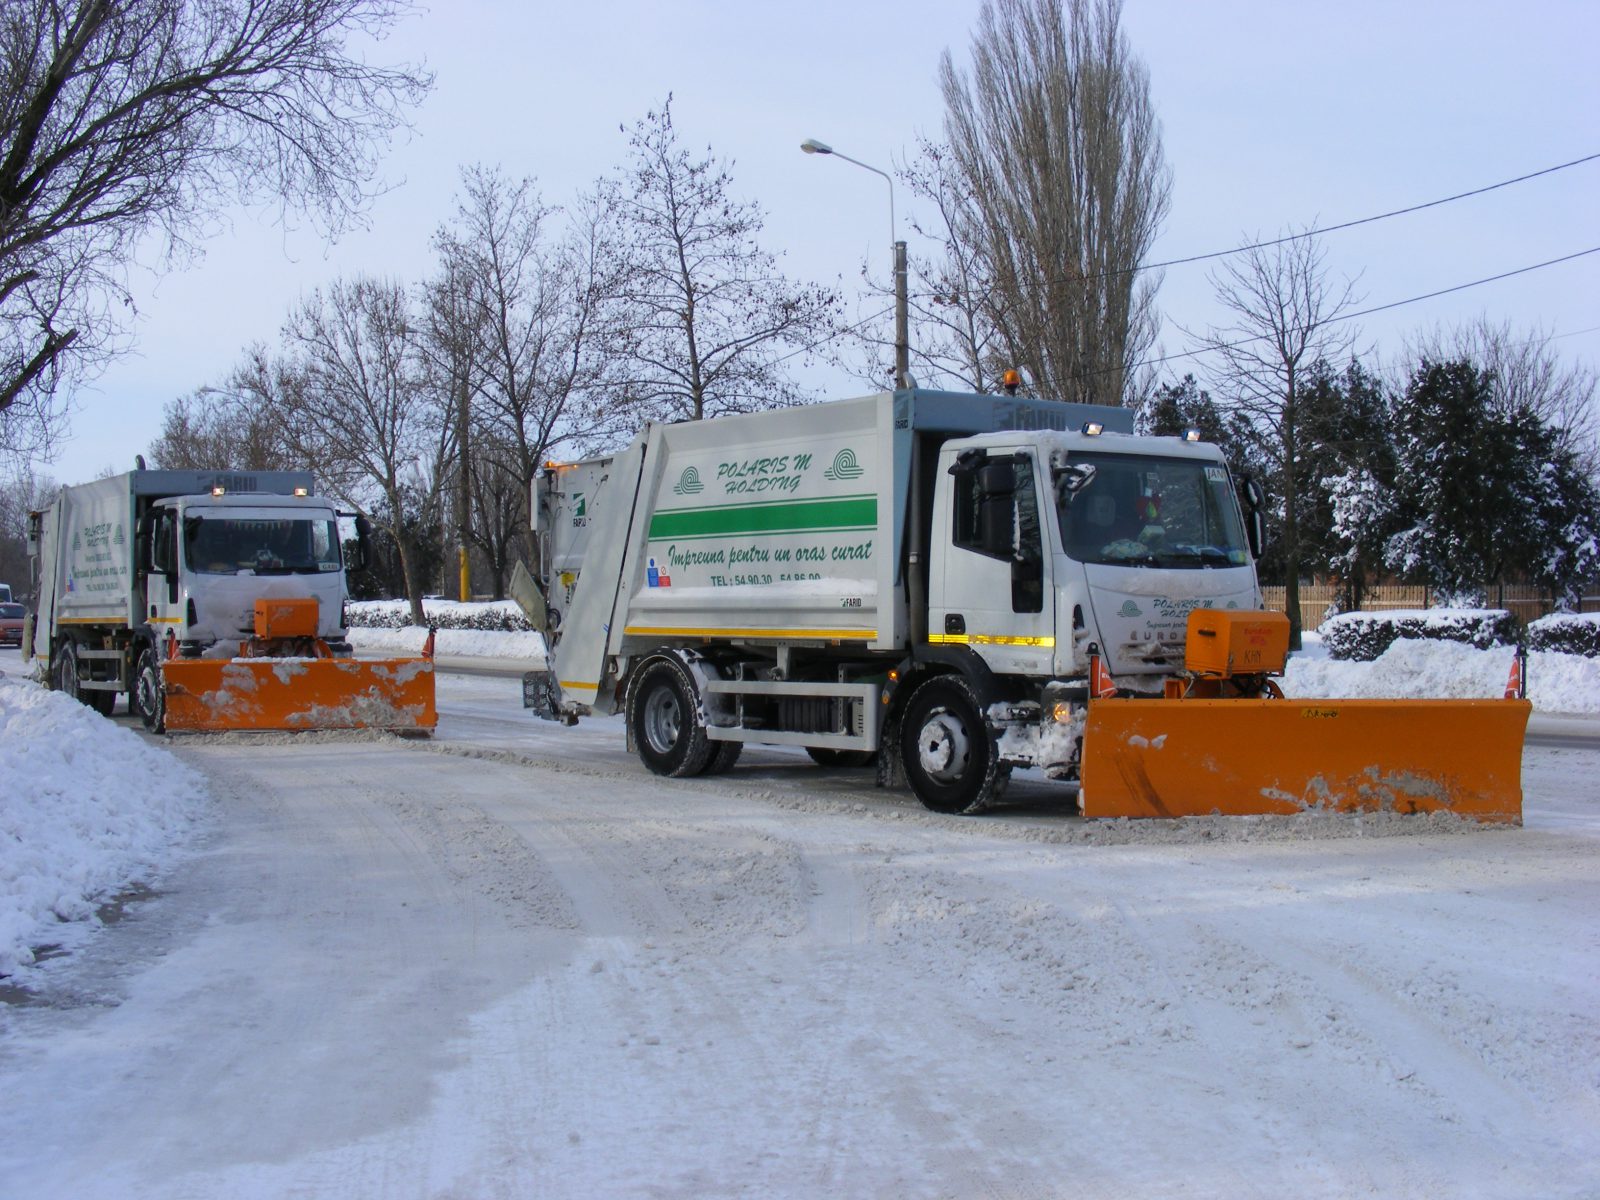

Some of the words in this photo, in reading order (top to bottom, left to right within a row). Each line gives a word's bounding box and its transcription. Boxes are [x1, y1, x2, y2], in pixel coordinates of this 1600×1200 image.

[717, 455, 790, 480] POLARIS
[793, 453, 813, 471] M
[725, 474, 802, 495] HOLDING
[668, 544, 725, 571] Impreuna
[728, 544, 770, 569] pentru
[774, 548, 793, 561] un
[795, 545, 827, 560] oras
[831, 540, 873, 561] curat
[1130, 630, 1187, 641] EURO
